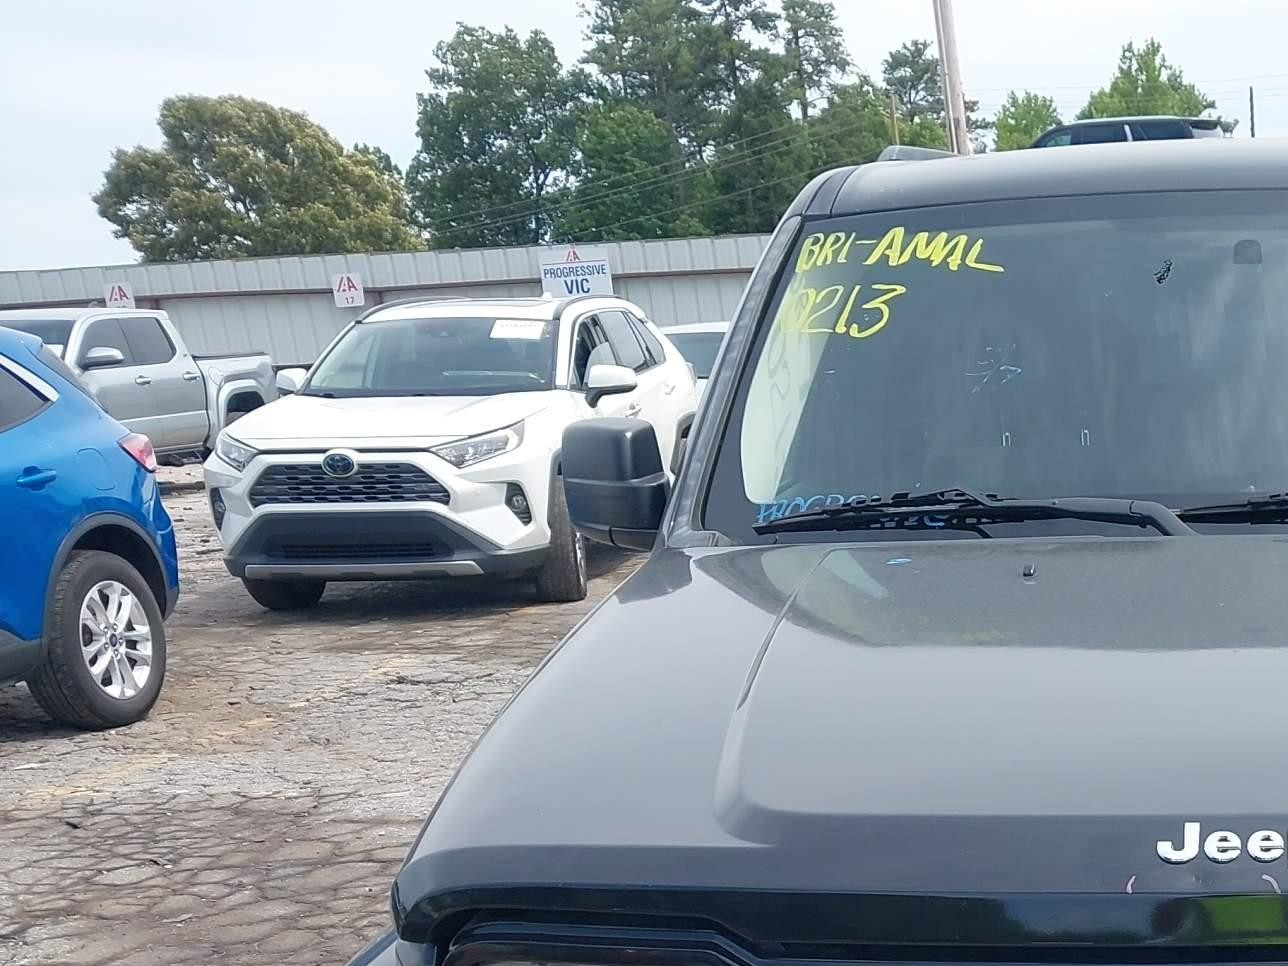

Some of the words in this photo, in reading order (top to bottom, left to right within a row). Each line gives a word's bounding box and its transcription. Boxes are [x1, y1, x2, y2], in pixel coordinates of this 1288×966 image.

[543, 264, 607, 279] PROGRESSIVE
[564, 278, 591, 295] VIC
[345, 296, 355, 304] 17
